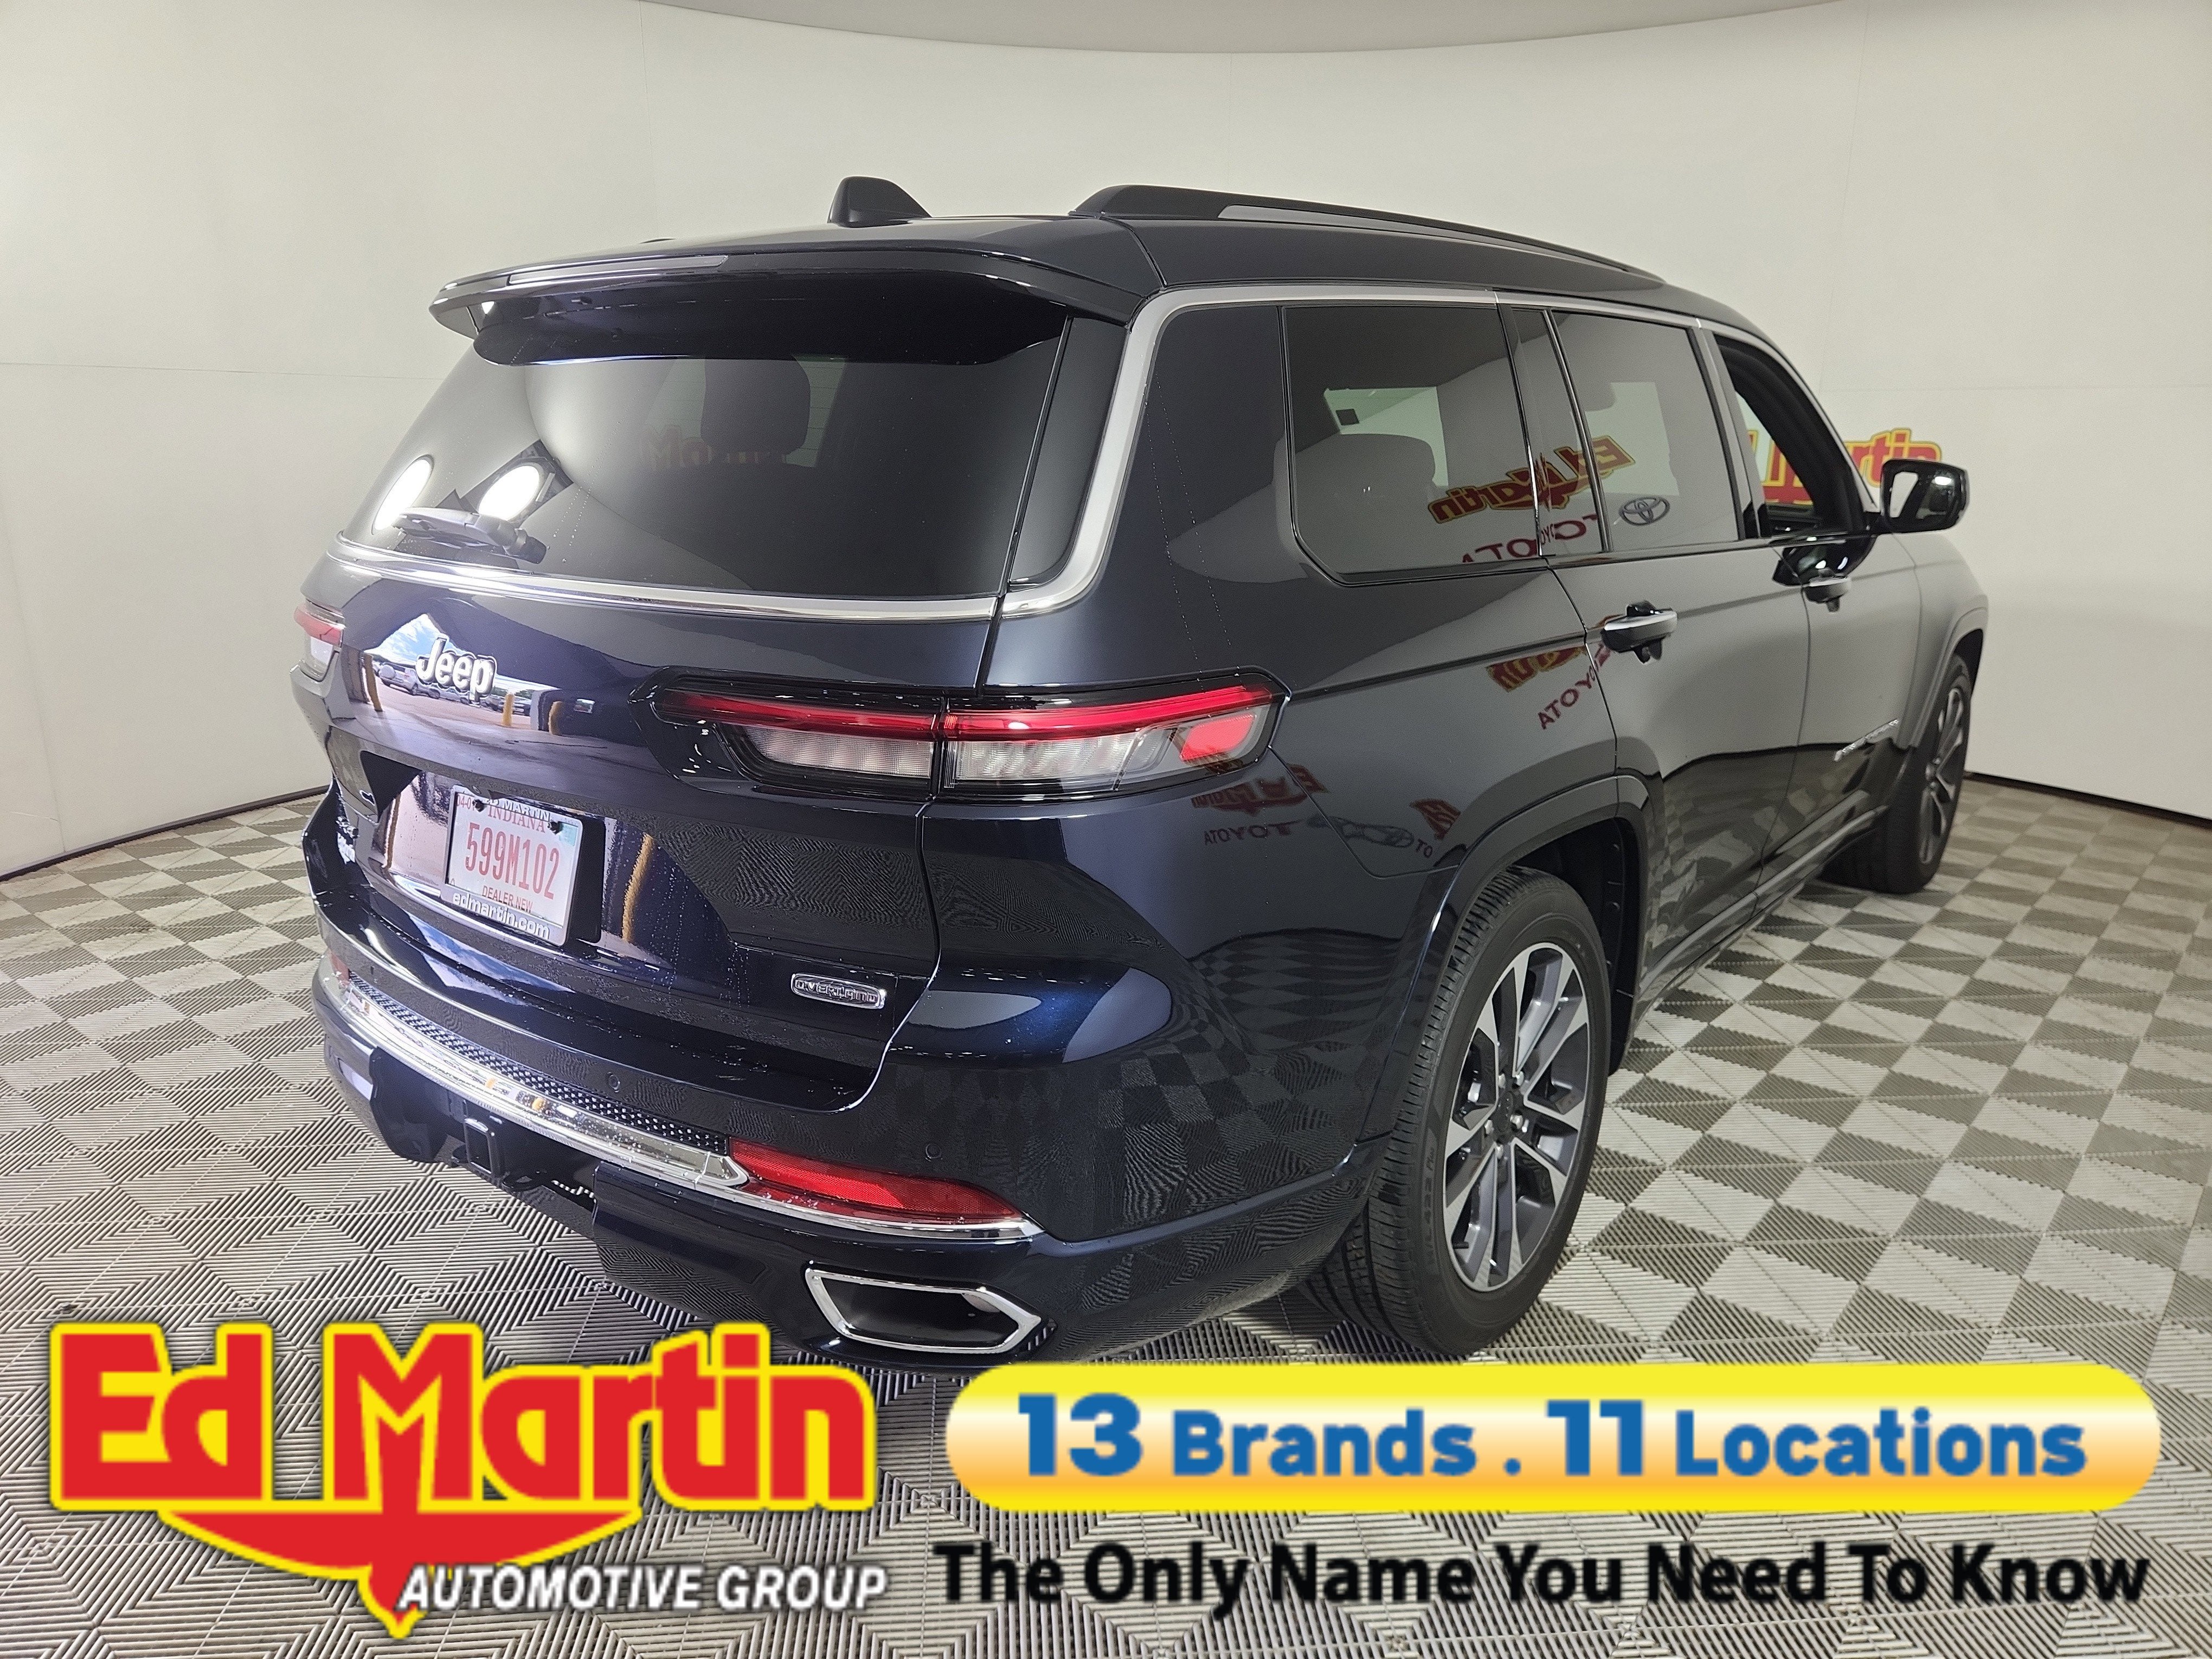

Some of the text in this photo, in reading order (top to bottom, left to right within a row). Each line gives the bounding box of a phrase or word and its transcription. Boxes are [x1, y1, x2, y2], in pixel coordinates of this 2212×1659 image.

[416, 637, 497, 703] Jeep
[488, 805, 546, 833] INDIANA
[503, 798, 551, 822] MARTIN
[465, 821, 561, 901] 599M102
[481, 885, 533, 914] DEALER NEW
[452, 891, 550, 941] edmartin.com
[794, 979, 878, 1003] OVERLAND
